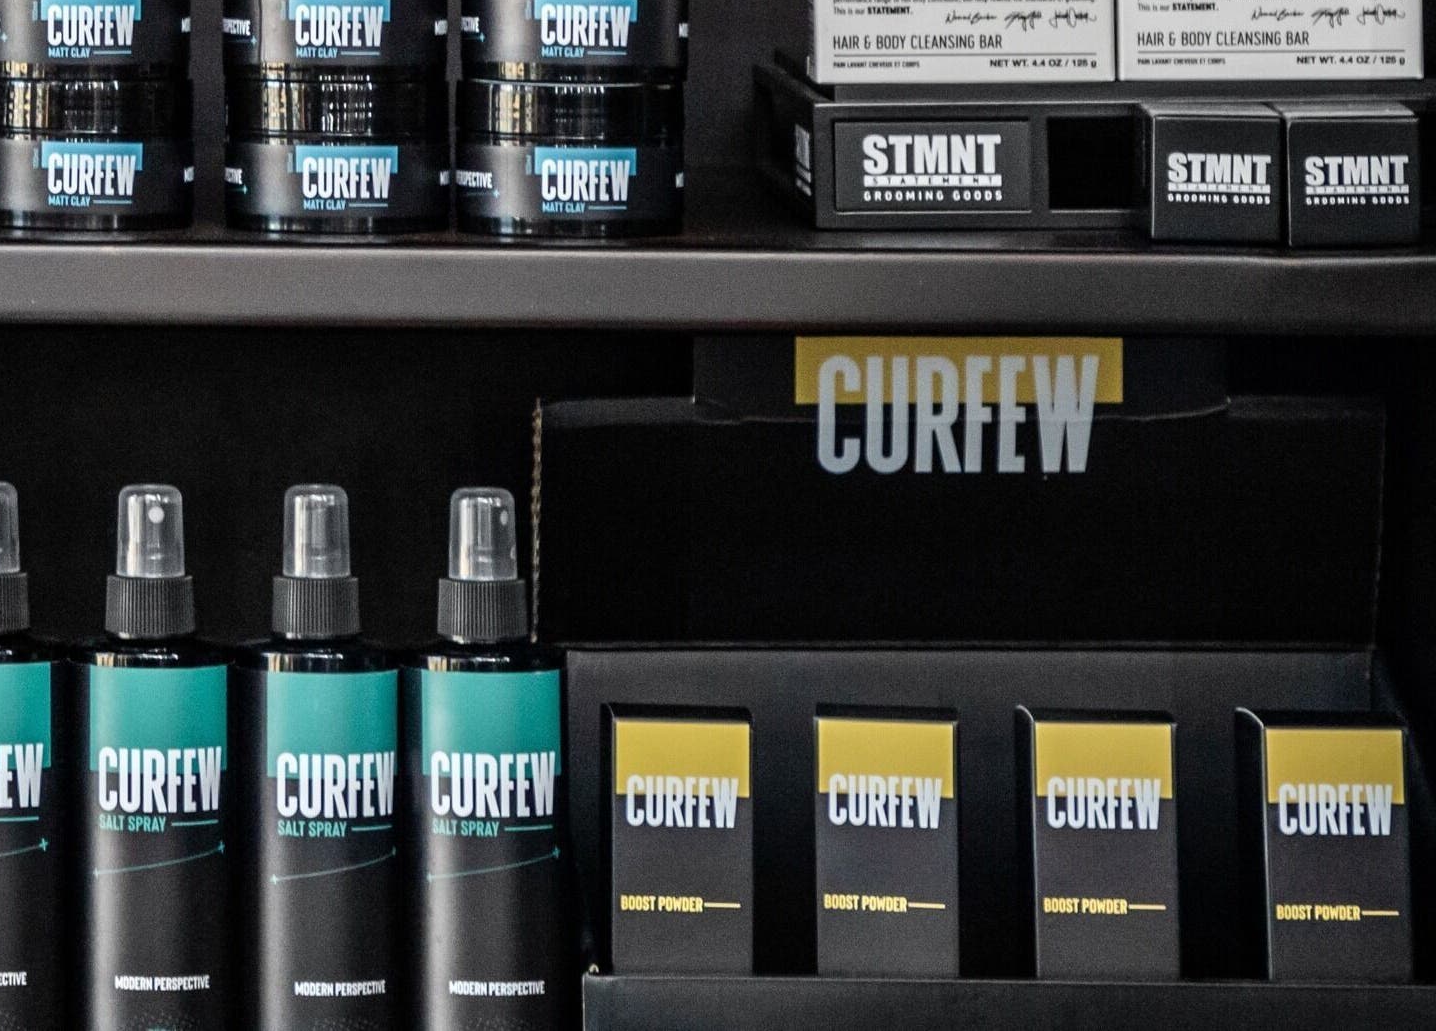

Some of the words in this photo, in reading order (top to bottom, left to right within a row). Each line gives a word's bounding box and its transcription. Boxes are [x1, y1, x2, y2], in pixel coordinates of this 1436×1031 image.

[46, 5, 136, 47] CURFEW
[294, 4, 384, 48] CURFEW
[540, 3, 631, 47] CURFEW
[833, 36, 860, 50] HAIR
[864, 36, 871, 50] &
[876, 36, 906, 50] BODY
[911, 35, 975, 50] CLEANSING
[980, 35, 1003, 49] BAR
[1137, 32, 1164, 47] HAIR
[1168, 32, 1176, 46] &
[1181, 31, 1211, 46] BODY
[1216, 31, 1282, 46] CLEANSING
[1286, 31, 1309, 45] BAR
[48, 47, 69, 58] MATT
[71, 47, 91, 58] CLAY
[296, 47, 316, 58] MATT
[318, 47, 338, 58] CLAY
[541, 47, 562, 57] MATT
[564, 47, 585, 58] CLAY
[990, 59, 1009, 67] NET
[1012, 59, 1030, 67] WT.
[1032, 59, 1046, 67] 4.4
[1048, 58, 1063, 67] OZ
[1072, 59, 1089, 67] 125
[863, 134, 1002, 175] STMNT
[47, 152, 136, 196] CURFEW
[302, 156, 392, 199] CURFEW
[1167, 152, 1271, 185] STMNT
[1305, 155, 1409, 186] STMNT
[541, 159, 631, 201] CURFEW
[48, 195, 69, 206] MATT
[71, 196, 91, 206] CLAY
[303, 199, 324, 210] MATT
[326, 199, 346, 210] CLAY
[864, 190, 944, 201] GROOMING
[953, 190, 1003, 201] GOODS
[1168, 193, 1228, 204] GROOMING
[1233, 194, 1271, 205] GOODS
[1306, 196, 1366, 206] GROOMING
[1372, 195, 1410, 205] GOODS
[542, 202, 563, 213] MATT
[564, 202, 585, 213] CLAY
[817, 354, 1100, 475] CURFEW
[98, 746, 222, 814] CURFEW
[276, 750, 395, 819] CURFEW
[430, 750, 556, 818] CURFEW
[626, 774, 739, 829] CURFEW
[828, 773, 943, 830] CURFEW
[1047, 775, 1161, 830] CURFEW
[1278, 783, 1393, 836] CURFEW
[99, 815, 122, 830] SALT
[124, 816, 166, 833] SPRAY
[277, 820, 305, 837] SALT
[308, 820, 347, 838] SPRAY
[431, 819, 457, 836] SALT
[460, 820, 500, 838] SPRAY
[620, 894, 656, 911] BOOST
[658, 895, 704, 913] POWDER
[823, 893, 859, 910] BOOST
[861, 894, 907, 913] POWDER
[1043, 897, 1079, 913] BOOST
[1082, 898, 1128, 915] POWDER
[1276, 904, 1311, 920] BOOST
[1314, 905, 1361, 921] POWDER
[114, 975, 153, 991] MODERN
[154, 974, 210, 991] PERSPECTIVE
[294, 981, 334, 997] MODERN
[335, 979, 385, 996] PERSPECTIVE
[449, 980, 487, 995] MODERN
[489, 980, 545, 996] PERSPECTIVE
